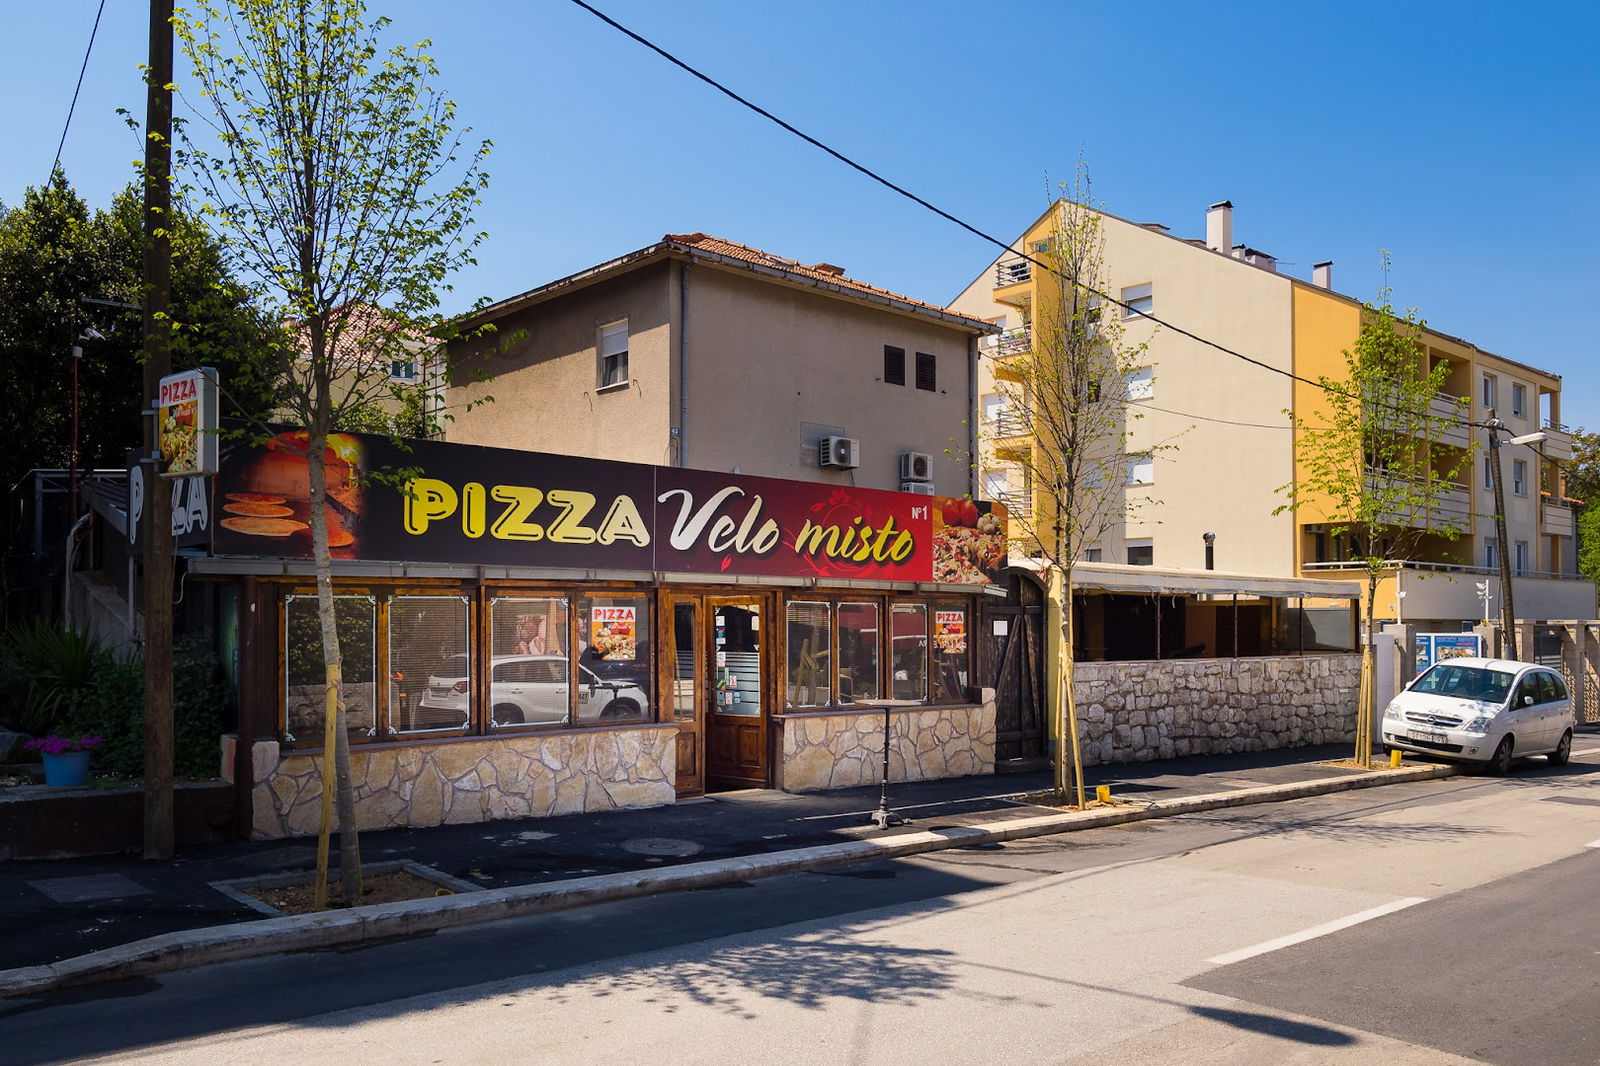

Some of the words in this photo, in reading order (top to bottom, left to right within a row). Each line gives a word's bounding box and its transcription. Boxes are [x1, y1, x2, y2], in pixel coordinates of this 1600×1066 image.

[160, 378, 197, 405] PIZZA
[403, 478, 651, 548] PIZZA
[657, 486, 780, 554] Velo
[795, 515, 914, 562] misto
[593, 608, 634, 620] PIZZA
[937, 613, 963, 622] PIZZA
